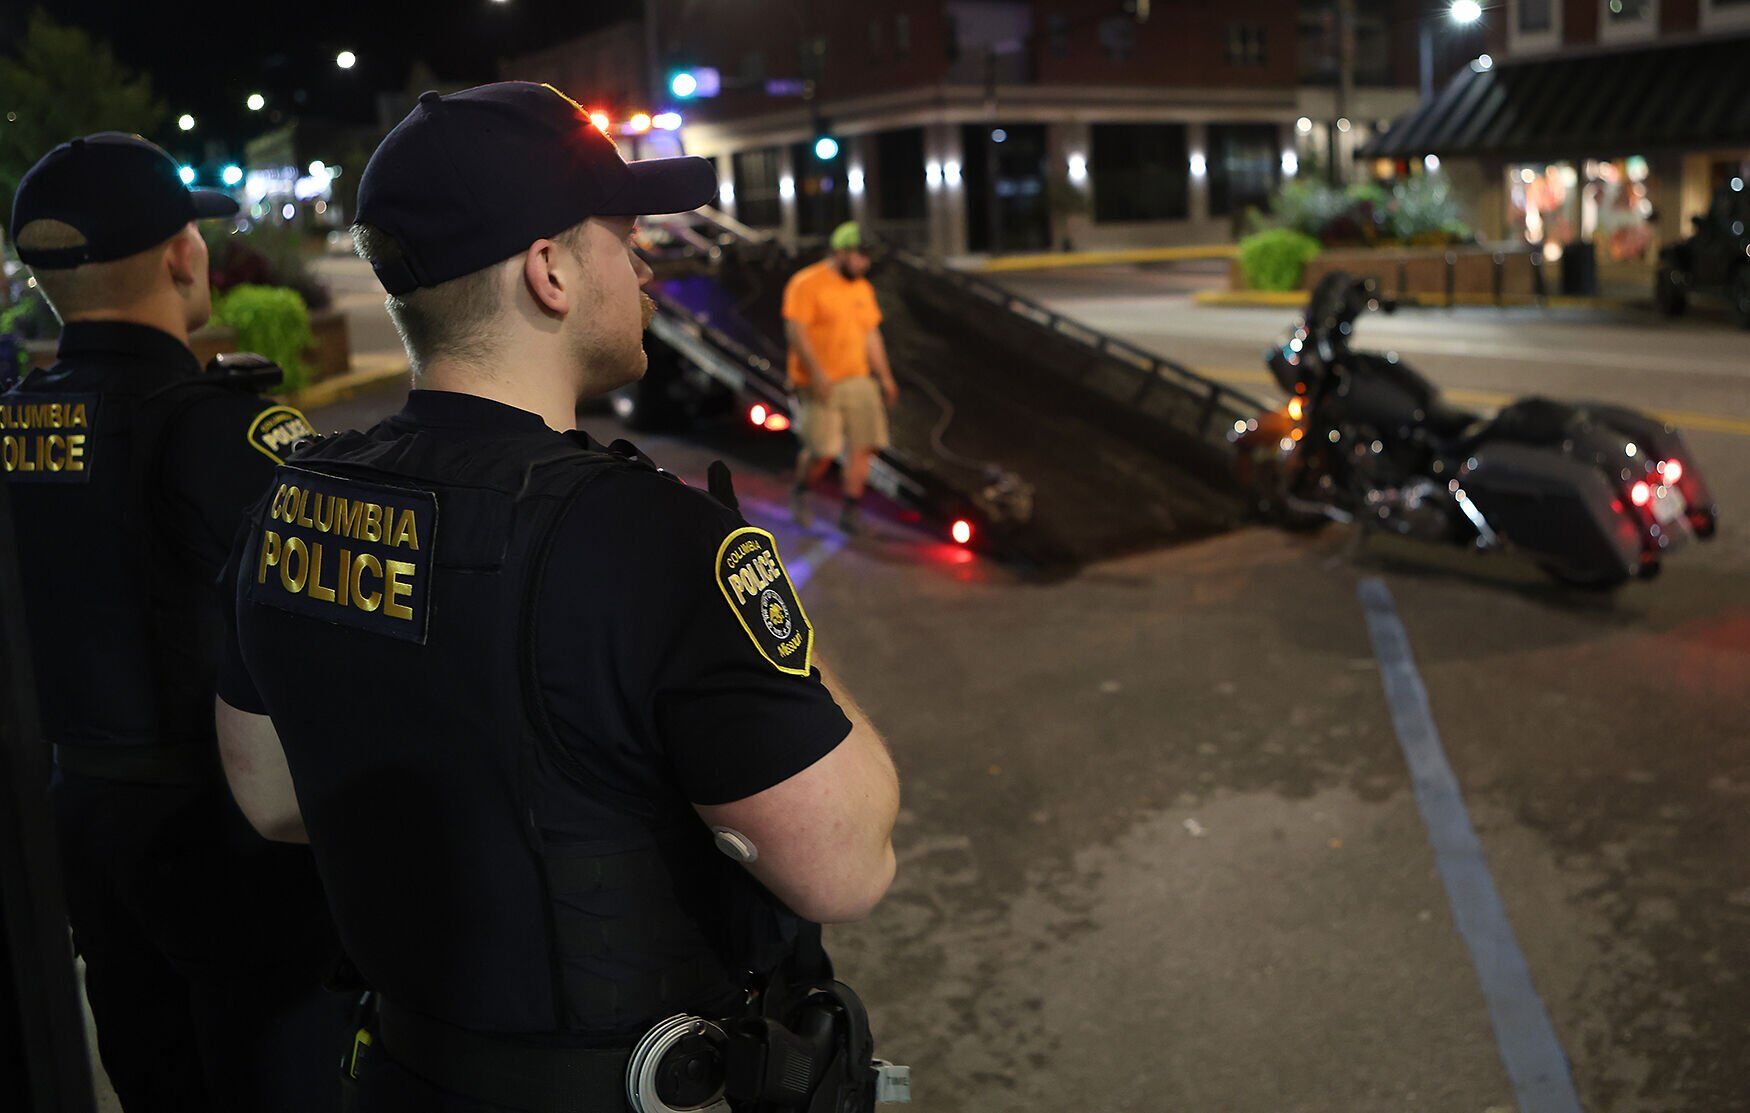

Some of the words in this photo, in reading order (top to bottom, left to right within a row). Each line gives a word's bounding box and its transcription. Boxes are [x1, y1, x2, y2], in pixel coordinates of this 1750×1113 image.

[0, 403, 87, 429] OLUMBIA
[2, 434, 86, 472] OLICE
[271, 484, 419, 550] COLUMBIA
[258, 530, 416, 620] POLICE
[727, 540, 762, 569] COLUMBIA
[728, 550, 781, 606] POLICE
